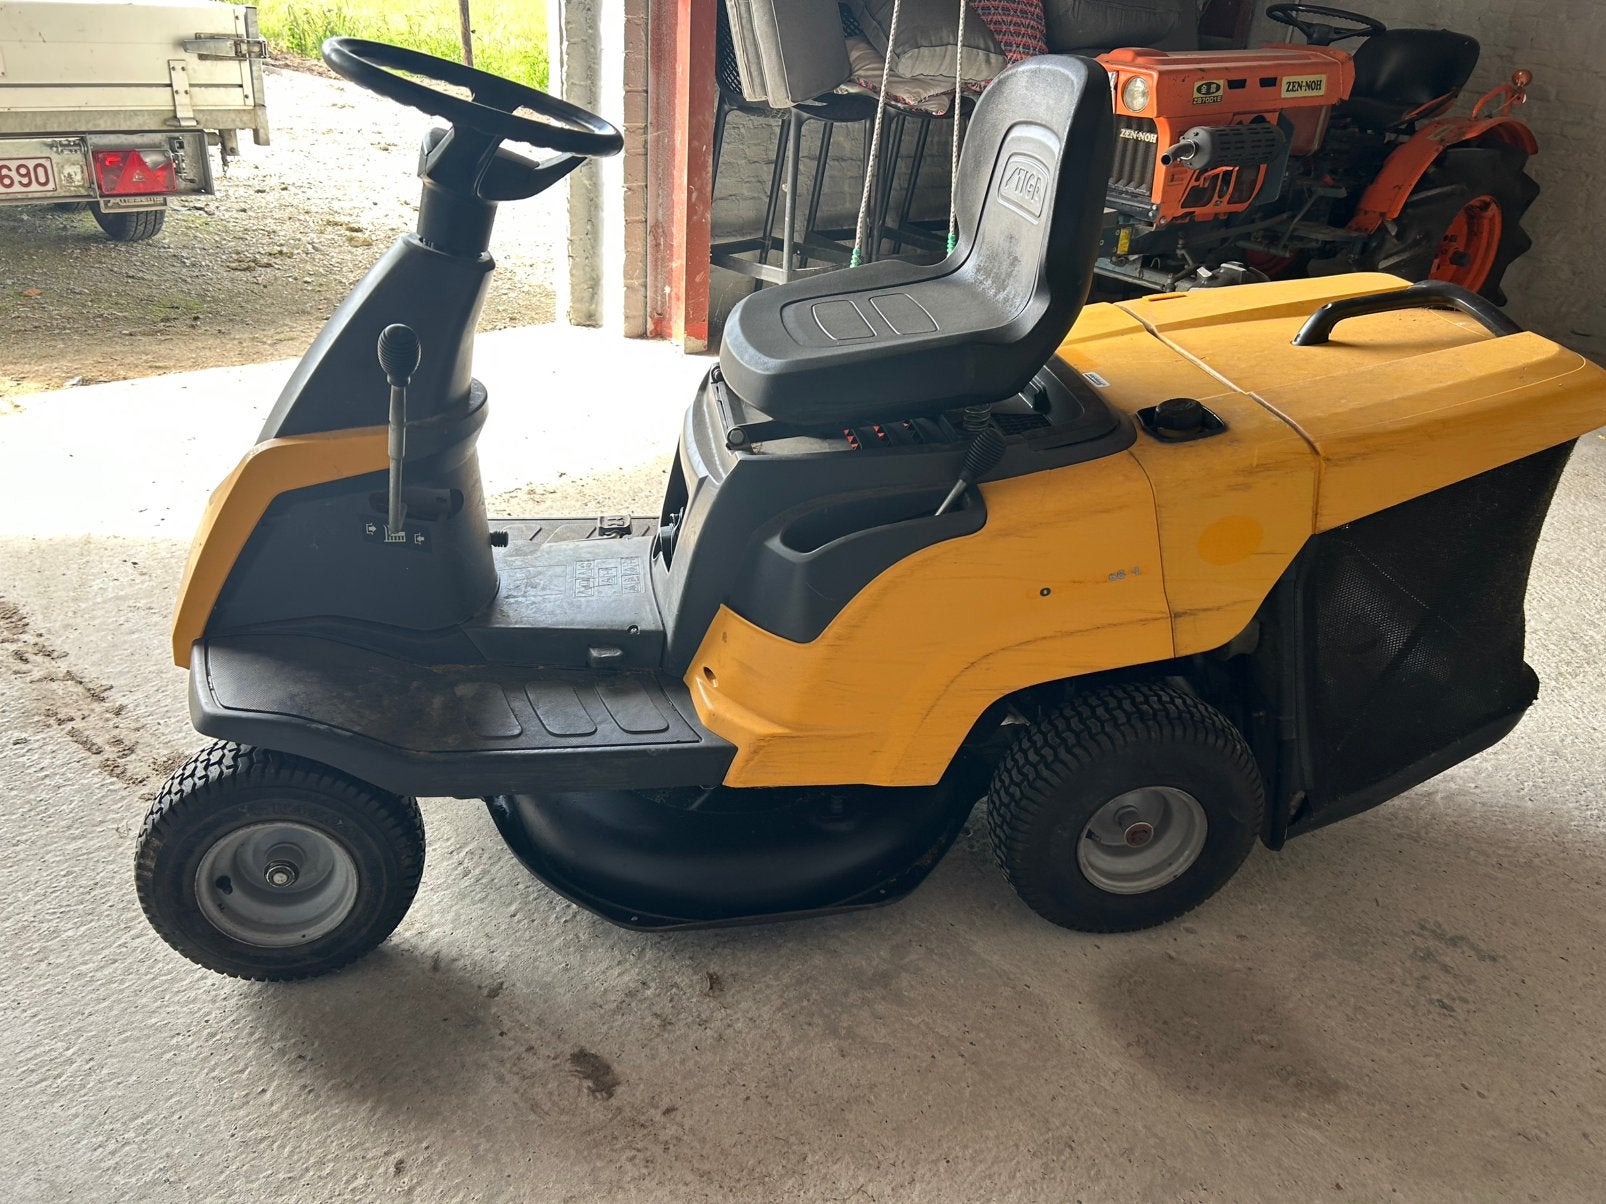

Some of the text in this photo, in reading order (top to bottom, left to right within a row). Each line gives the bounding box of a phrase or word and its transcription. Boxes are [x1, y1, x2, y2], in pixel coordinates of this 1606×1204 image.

[1285, 80, 1322, 92] ZEN-NOH
[1120, 129, 1157, 143] ZEN-NOH
[0, 163, 50, 189] 690
